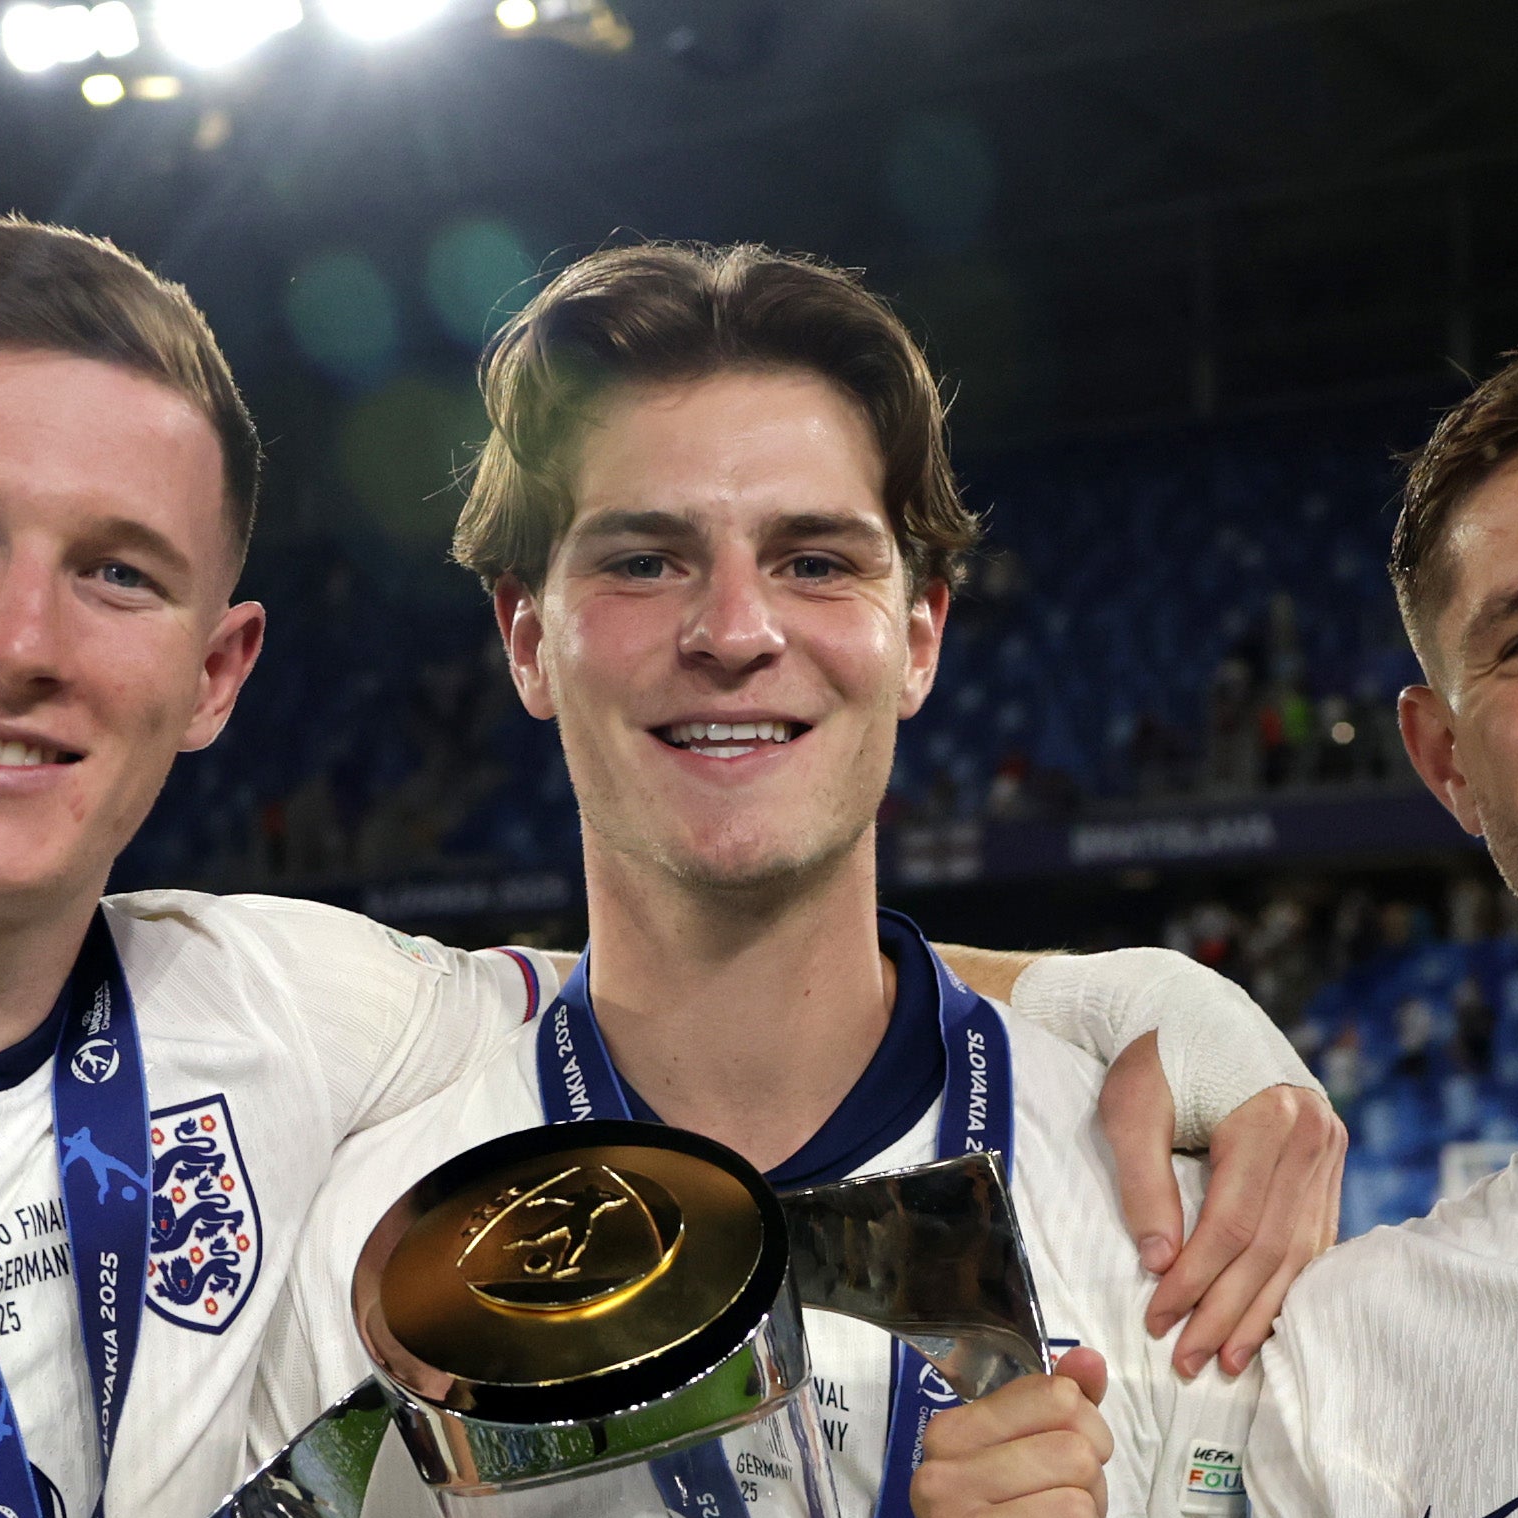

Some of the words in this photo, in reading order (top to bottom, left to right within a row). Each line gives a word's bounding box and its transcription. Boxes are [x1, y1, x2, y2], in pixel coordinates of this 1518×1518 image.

[554, 1004, 574, 1058] 2025
[562, 1055, 595, 1121] VAKIA
[966, 1027, 988, 1131] SLOVAKIA
[100, 1251, 118, 1323] 2025
[101, 1328, 118, 1457] SLOVAKIA
[812, 1376, 850, 1412] NAL
[735, 1452, 794, 1483] GERMANY
[1193, 1447, 1234, 1463] UEFA
